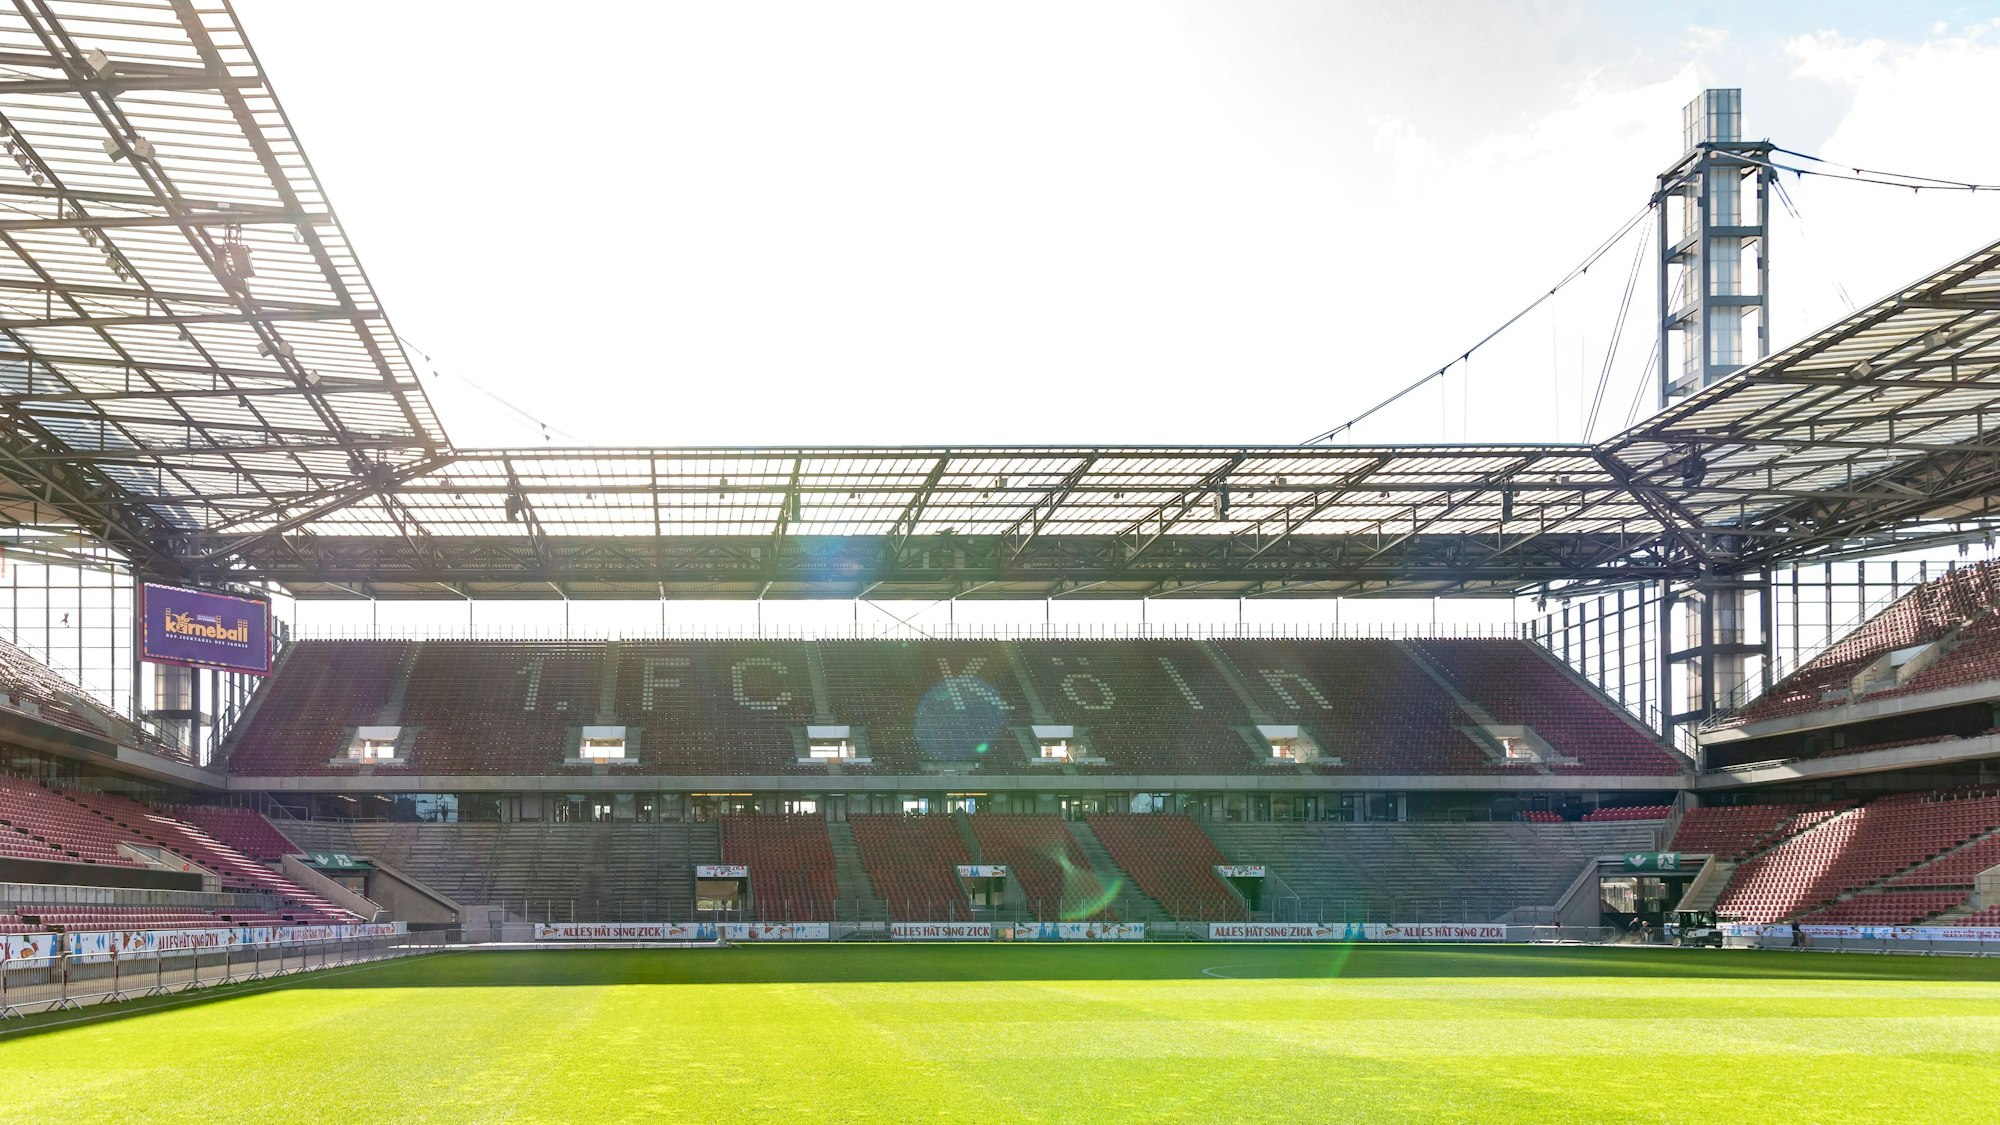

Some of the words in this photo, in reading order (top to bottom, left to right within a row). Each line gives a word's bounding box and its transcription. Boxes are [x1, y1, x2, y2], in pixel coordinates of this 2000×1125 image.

[166, 608, 248, 642] karneball
[516, 657, 568, 710] 1.
[642, 657, 792, 711] FC
[936, 657, 1333, 711] Köln
[563, 926, 592, 937] ALLES
[594, 925, 611, 937] HÄT
[613, 926, 635, 937] SING
[637, 926, 661, 937] ZICK
[892, 926, 921, 937] ALLES
[923, 924, 941, 937] HÄT
[942, 926, 965, 937] SING
[966, 926, 990, 937] ZICK
[1215, 926, 1243, 937] ALLES
[1245, 925, 1262, 937] HÄT
[1264, 926, 1287, 937] SING
[1289, 926, 1313, 937] ZICK
[1403, 927, 1433, 937] ALLES
[1435, 925, 1452, 937] HÄT
[1454, 927, 1477, 937] SING
[1479, 927, 1503, 938] ZICK
